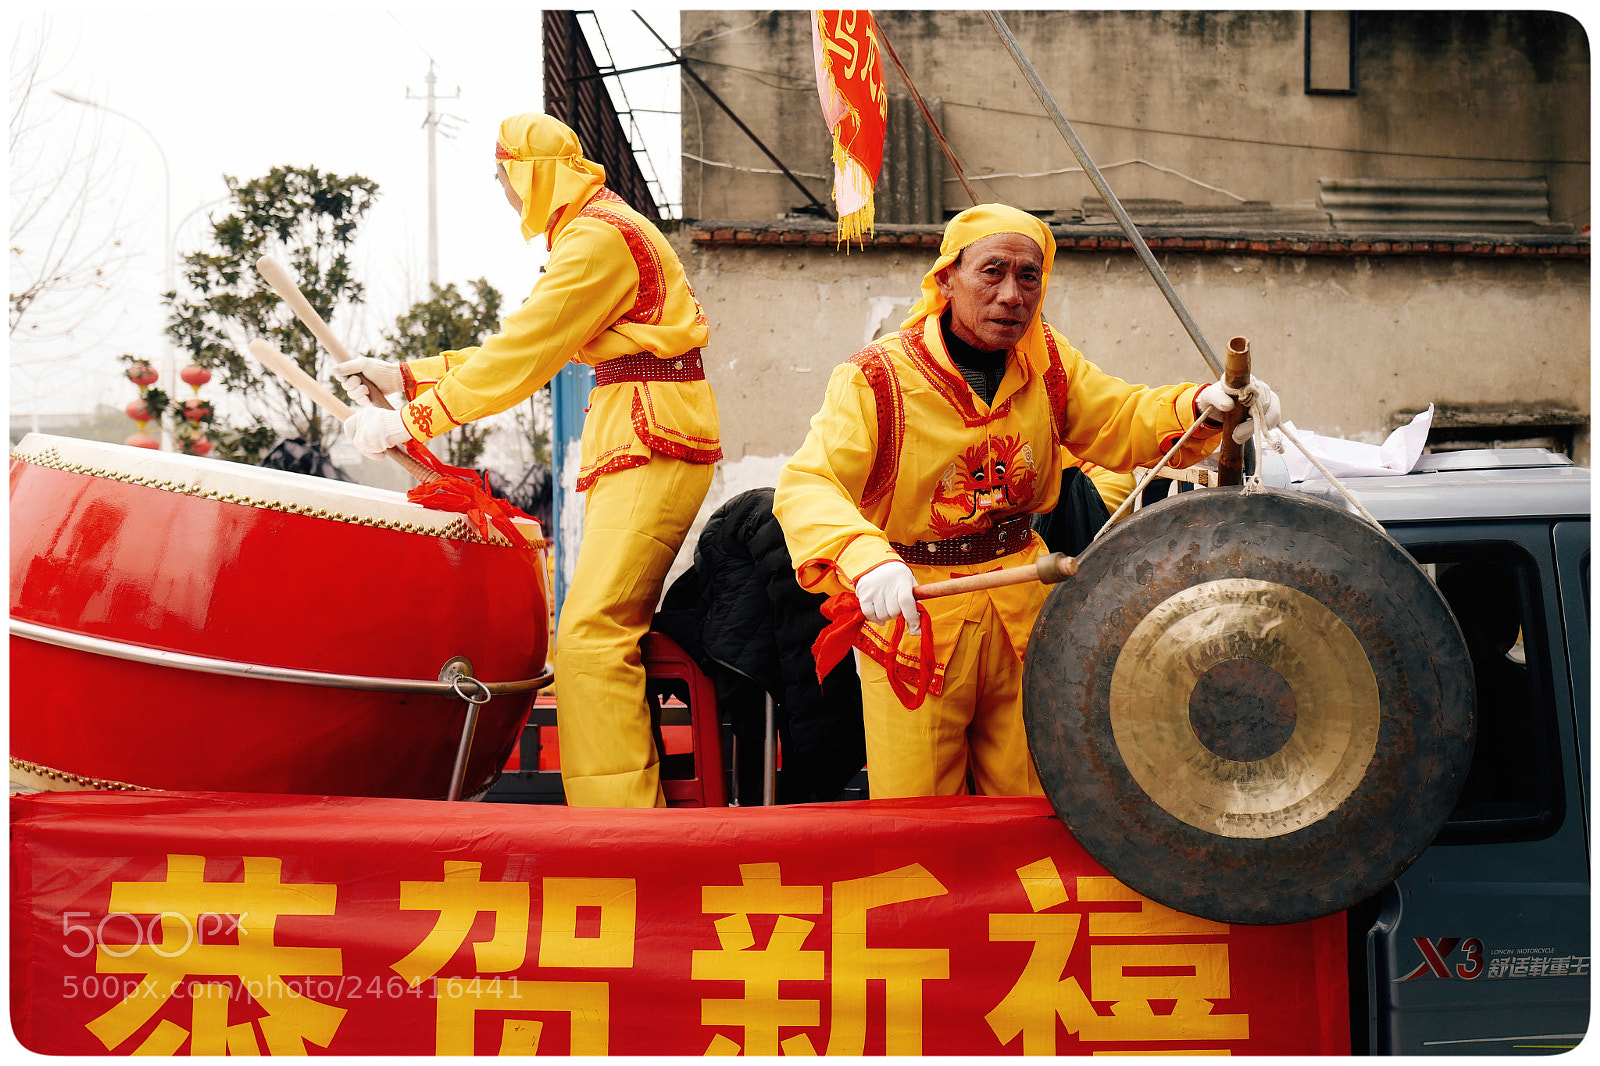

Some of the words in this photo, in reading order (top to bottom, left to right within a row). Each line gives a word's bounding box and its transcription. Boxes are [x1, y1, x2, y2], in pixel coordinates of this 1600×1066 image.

[85, 853, 1250, 1057] 恭贺新禧
[1391, 937, 1484, 981] X3
[1487, 954, 1591, 978] 舒适载重王
